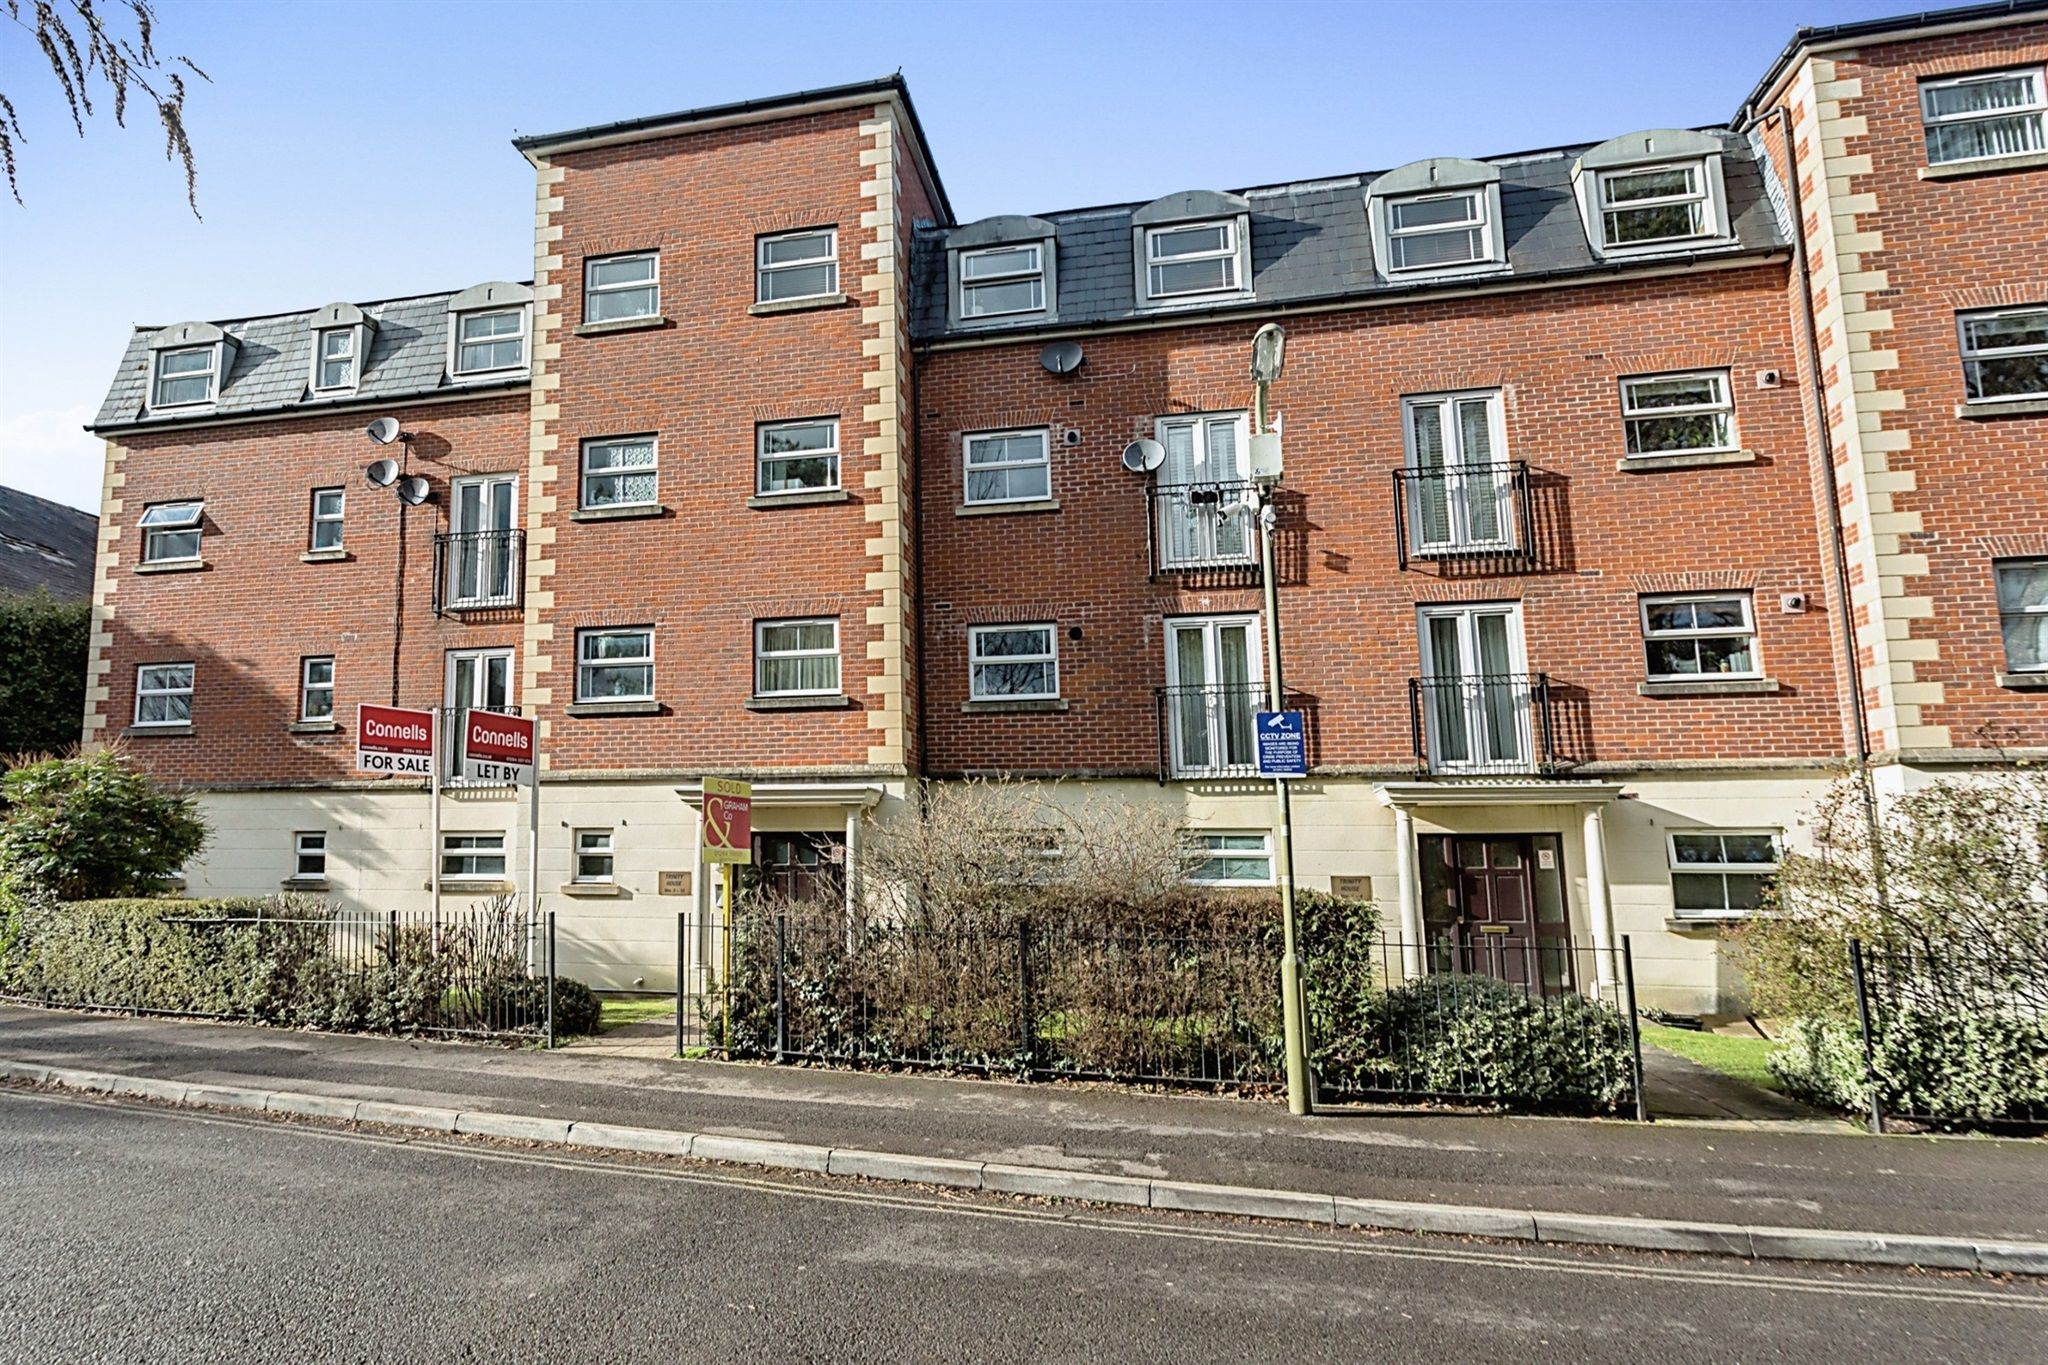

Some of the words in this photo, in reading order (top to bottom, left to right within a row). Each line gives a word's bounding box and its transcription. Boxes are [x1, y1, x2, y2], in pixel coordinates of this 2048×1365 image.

[366, 719, 427, 741] Connells
[472, 725, 528, 749] Connells
[364, 755, 393, 770] FOR
[398, 757, 430, 772] SALE
[477, 764, 500, 779] LET
[504, 766, 520, 780] BY
[718, 781, 741, 794] SOLD
[724, 800, 748, 812] GRAHAM
[724, 811, 732, 820] Co
